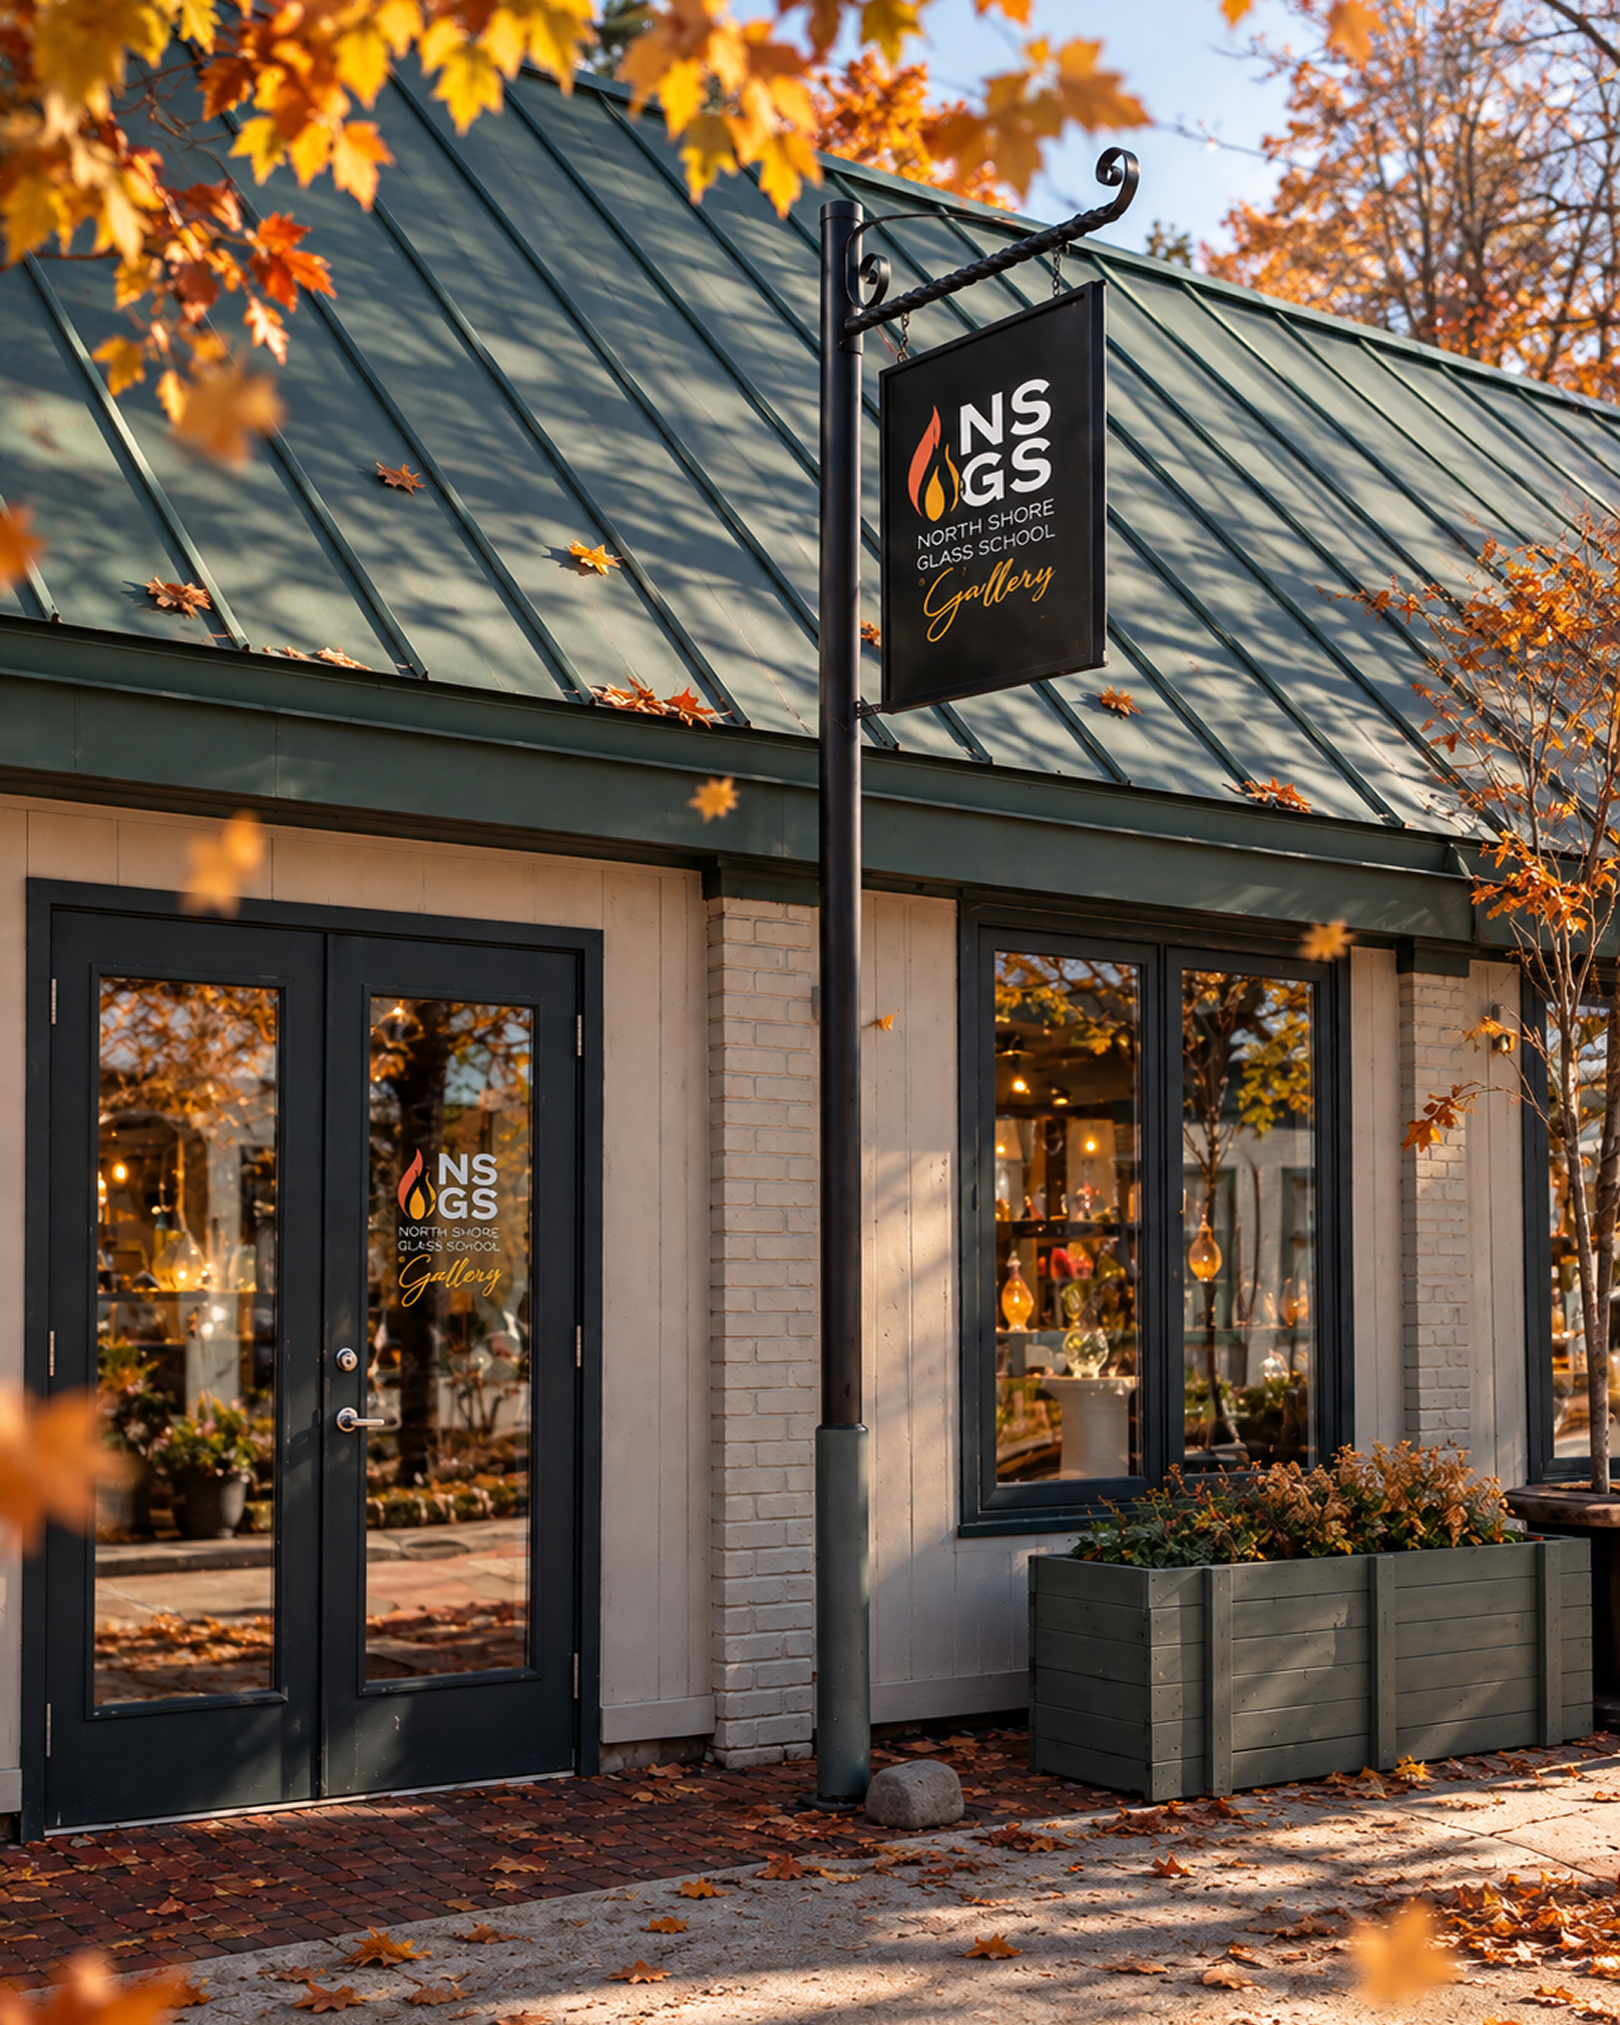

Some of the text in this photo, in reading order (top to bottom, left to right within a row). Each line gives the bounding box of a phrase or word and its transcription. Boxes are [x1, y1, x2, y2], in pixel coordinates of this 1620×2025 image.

[960, 378, 1052, 456] NS
[960, 437, 1052, 507] GS
[916, 524, 1056, 571] GLASS SCHOOL
[917, 499, 1055, 550] NORTH SHORE
[923, 558, 1057, 642] Gallery
[438, 1152, 498, 1186] NS
[437, 1187, 498, 1220] GS
[397, 1240, 501, 1252] GLASS SCHOOL
[398, 1226, 447, 1238] NORTH
[398, 1254, 502, 1307] Gallery
